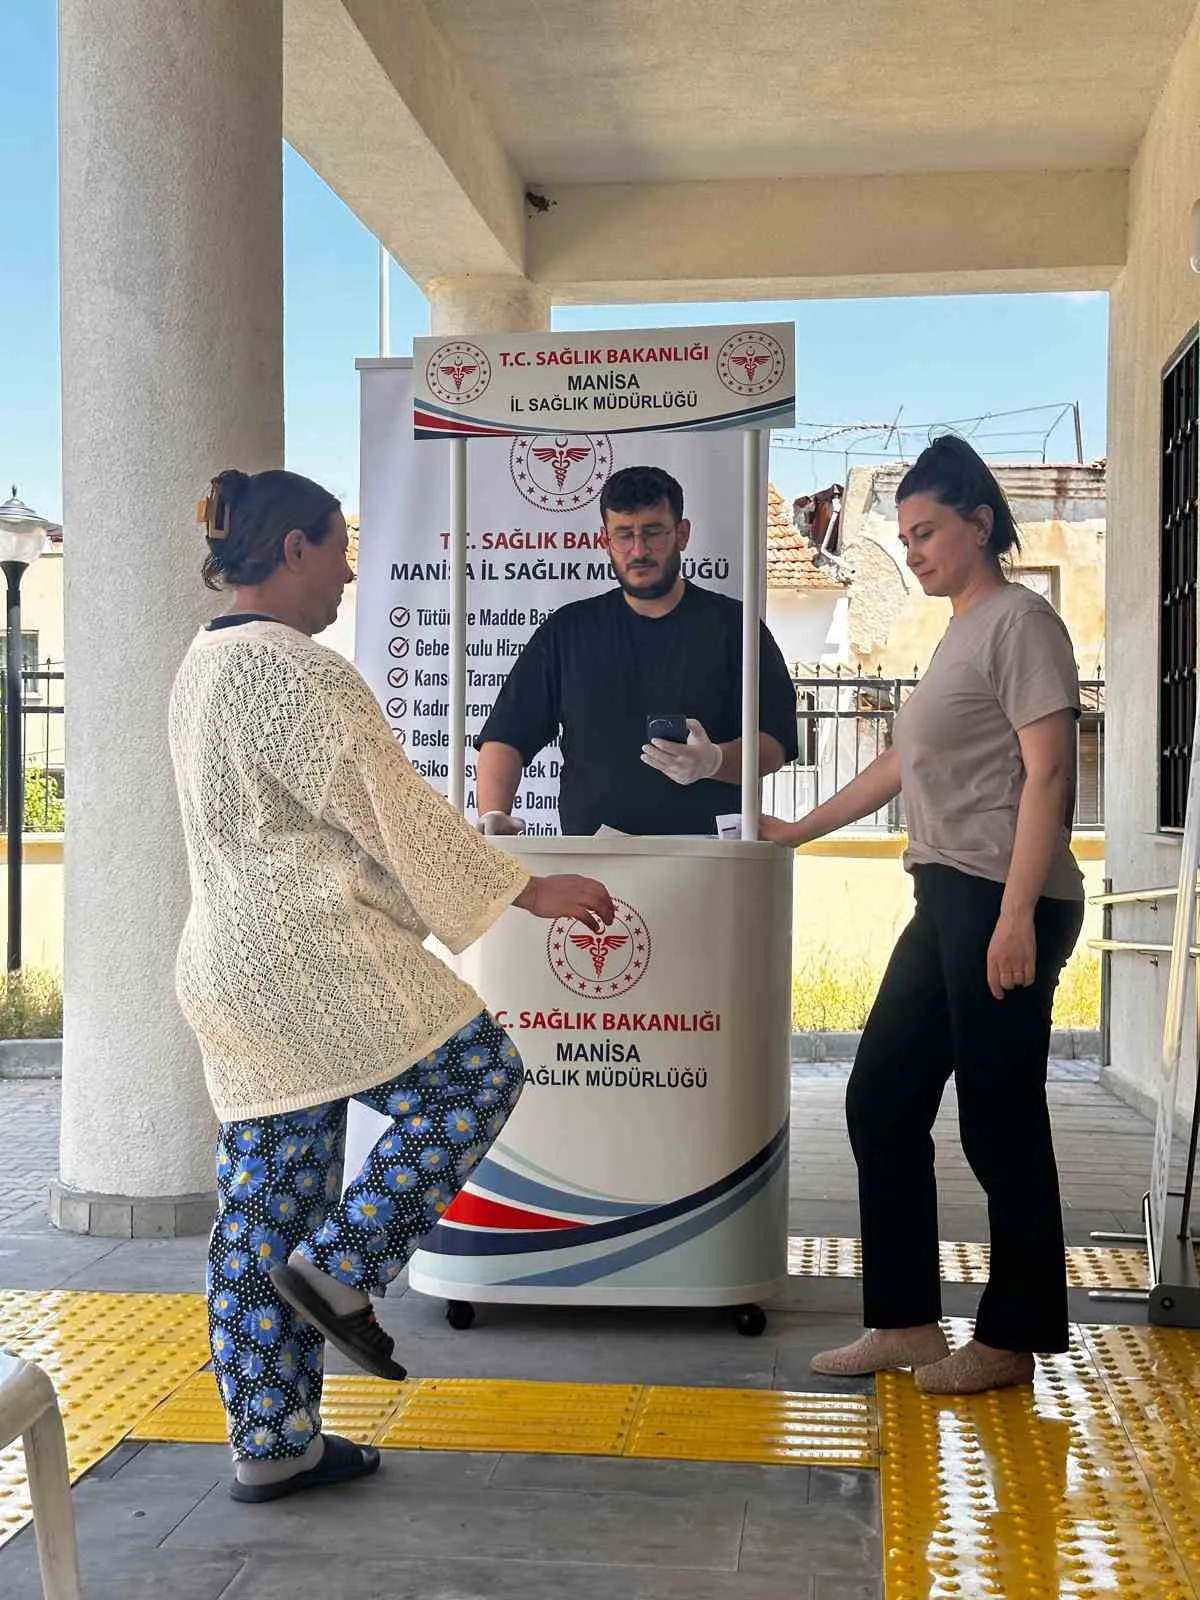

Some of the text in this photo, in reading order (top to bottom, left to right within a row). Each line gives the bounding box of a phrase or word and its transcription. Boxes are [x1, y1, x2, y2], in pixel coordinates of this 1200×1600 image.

[499, 342, 709, 367] T.C. SAĞLIK BAKANLIĞI
[567, 370, 640, 391] MANİSA
[510, 390, 698, 412] İL SAĞLIK MÜDÜRLÜĞÜ
[482, 528, 558, 550] SAĞLIK
[481, 559, 499, 581] İL
[504, 558, 581, 580] SAĞLIK
[479, 607, 526, 626] Madde
[415, 638, 450, 657] Gebe
[414, 669, 449, 687] Kans
[519, 1007, 597, 1030] SAĞLIK
[602, 1009, 721, 1032] BAKANLIĞI
[556, 1038, 641, 1063] MANİSA
[523, 1065, 708, 1089] AĞLIK MÜDÜRLÜĞÜ
